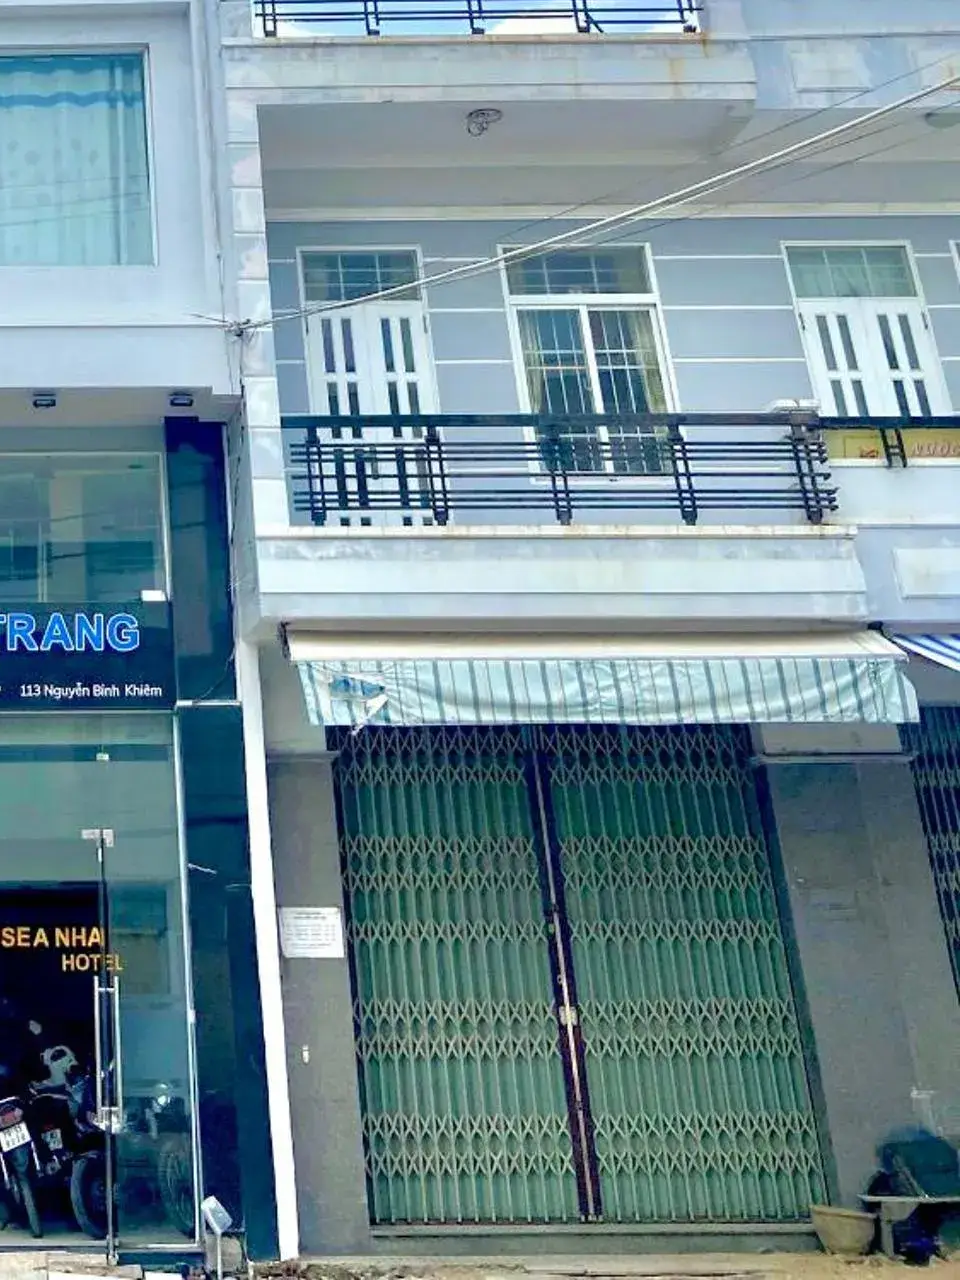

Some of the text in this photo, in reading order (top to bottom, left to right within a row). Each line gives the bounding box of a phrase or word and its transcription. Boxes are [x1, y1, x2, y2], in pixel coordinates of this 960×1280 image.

[20, 684, 41, 697] 113
[54, 926, 105, 948] NHA
[61, 953, 124, 972] HOTEL
